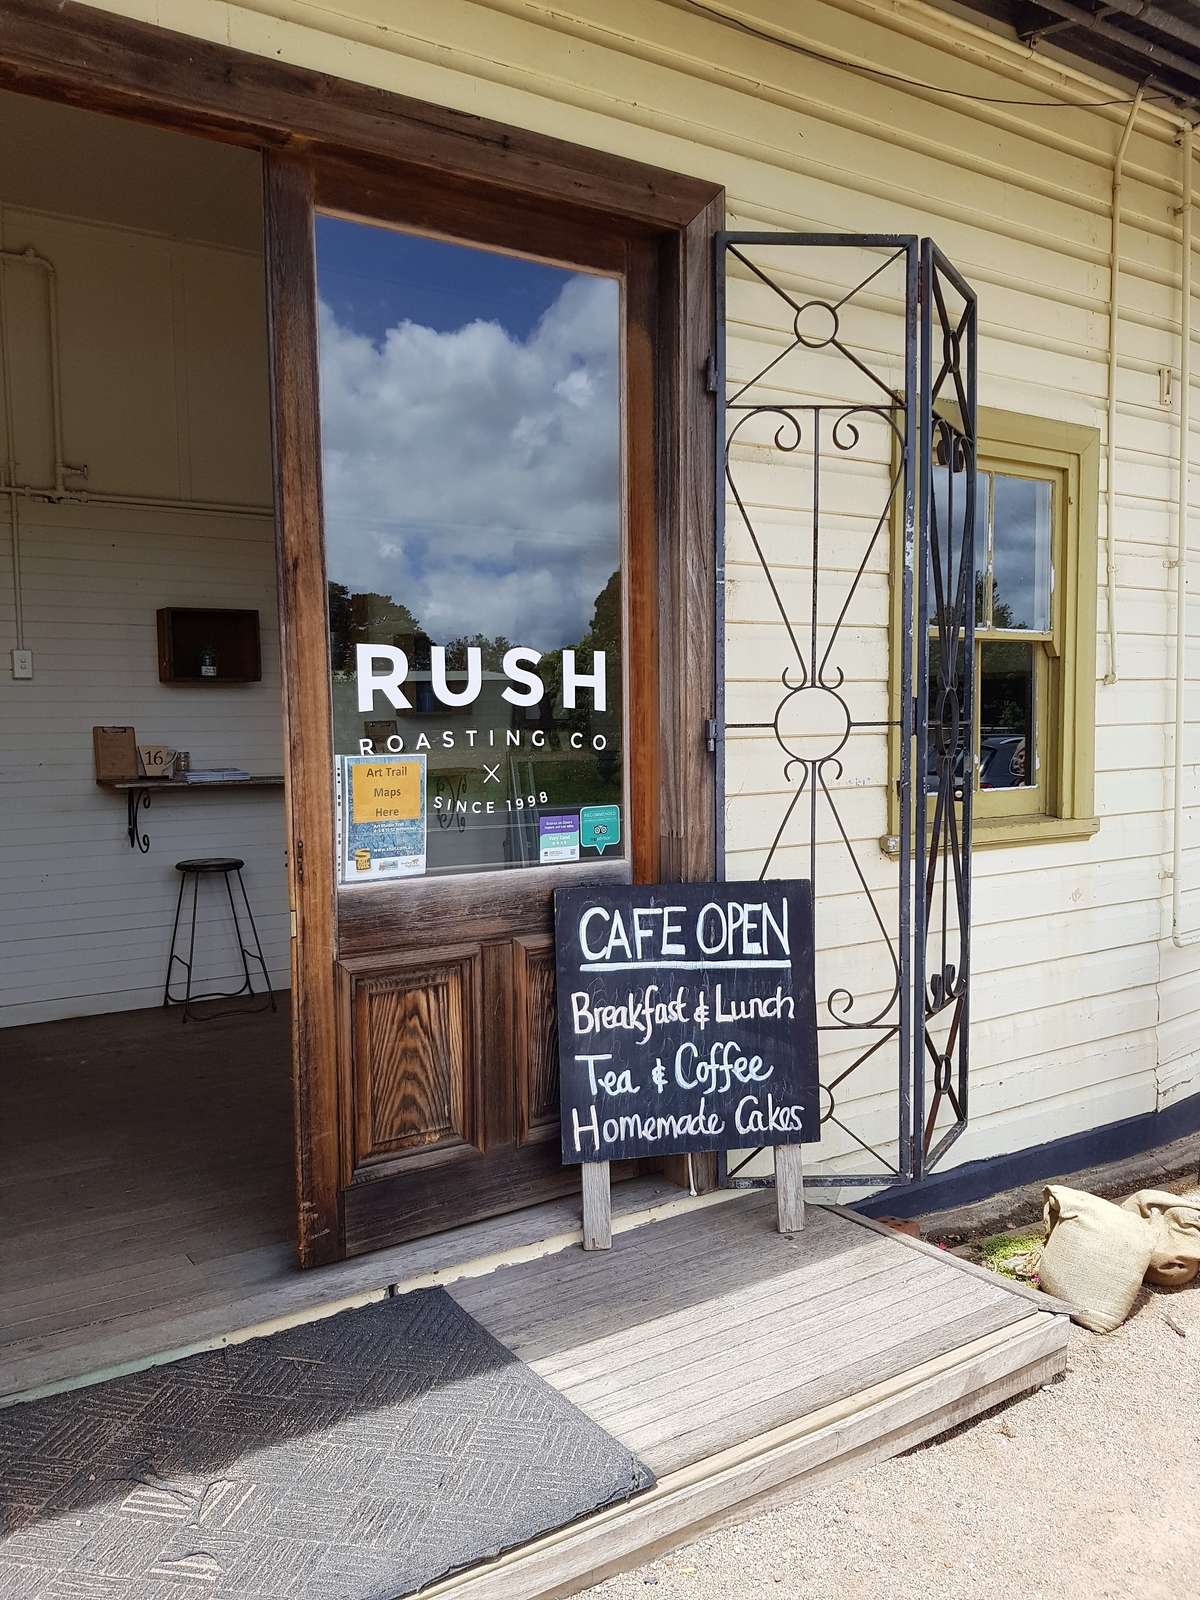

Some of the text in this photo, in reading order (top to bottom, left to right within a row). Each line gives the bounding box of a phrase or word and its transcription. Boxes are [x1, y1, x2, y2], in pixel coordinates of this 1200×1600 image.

[356, 643, 607, 713] RUSH
[359, 730, 607, 756] ROASTING CO
[144, 750, 163, 766] 16
[366, 766, 407, 778] Art Trail
[373, 787, 402, 798] Maps
[433, 791, 549, 814] SINCE 1998
[375, 807, 400, 817] Here
[579, 897, 791, 961] CAFE OPEN
[571, 983, 795, 1045] Breakfast & Lunch
[574, 1041, 775, 1096] Tea & Coffee
[571, 1092, 805, 1152] Homemade Cakes
